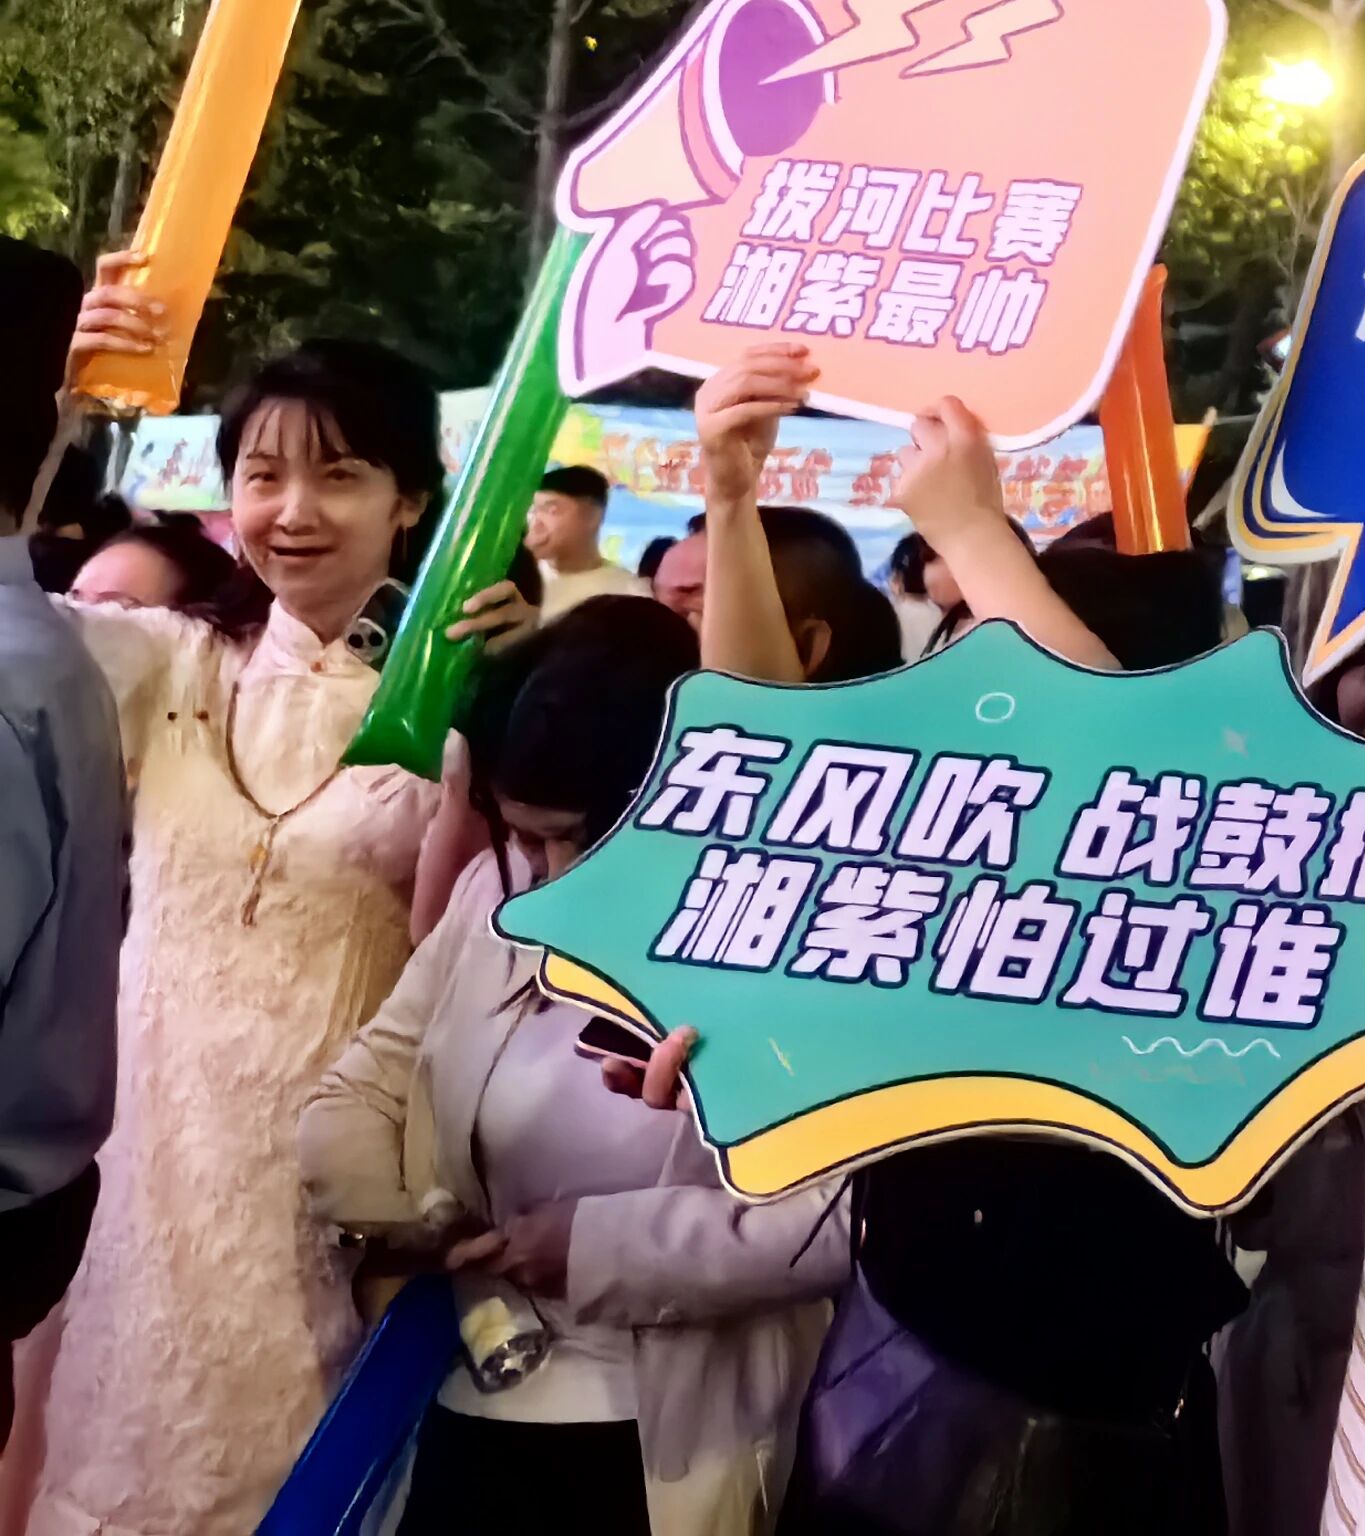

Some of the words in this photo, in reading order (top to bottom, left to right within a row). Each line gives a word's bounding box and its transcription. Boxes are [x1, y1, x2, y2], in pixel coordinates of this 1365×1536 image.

[701, 244, 1049, 355] 湘紫最帅
[637, 723, 1049, 873] 东风吹
[648, 846, 1343, 1030] 湘紫怕过谁
